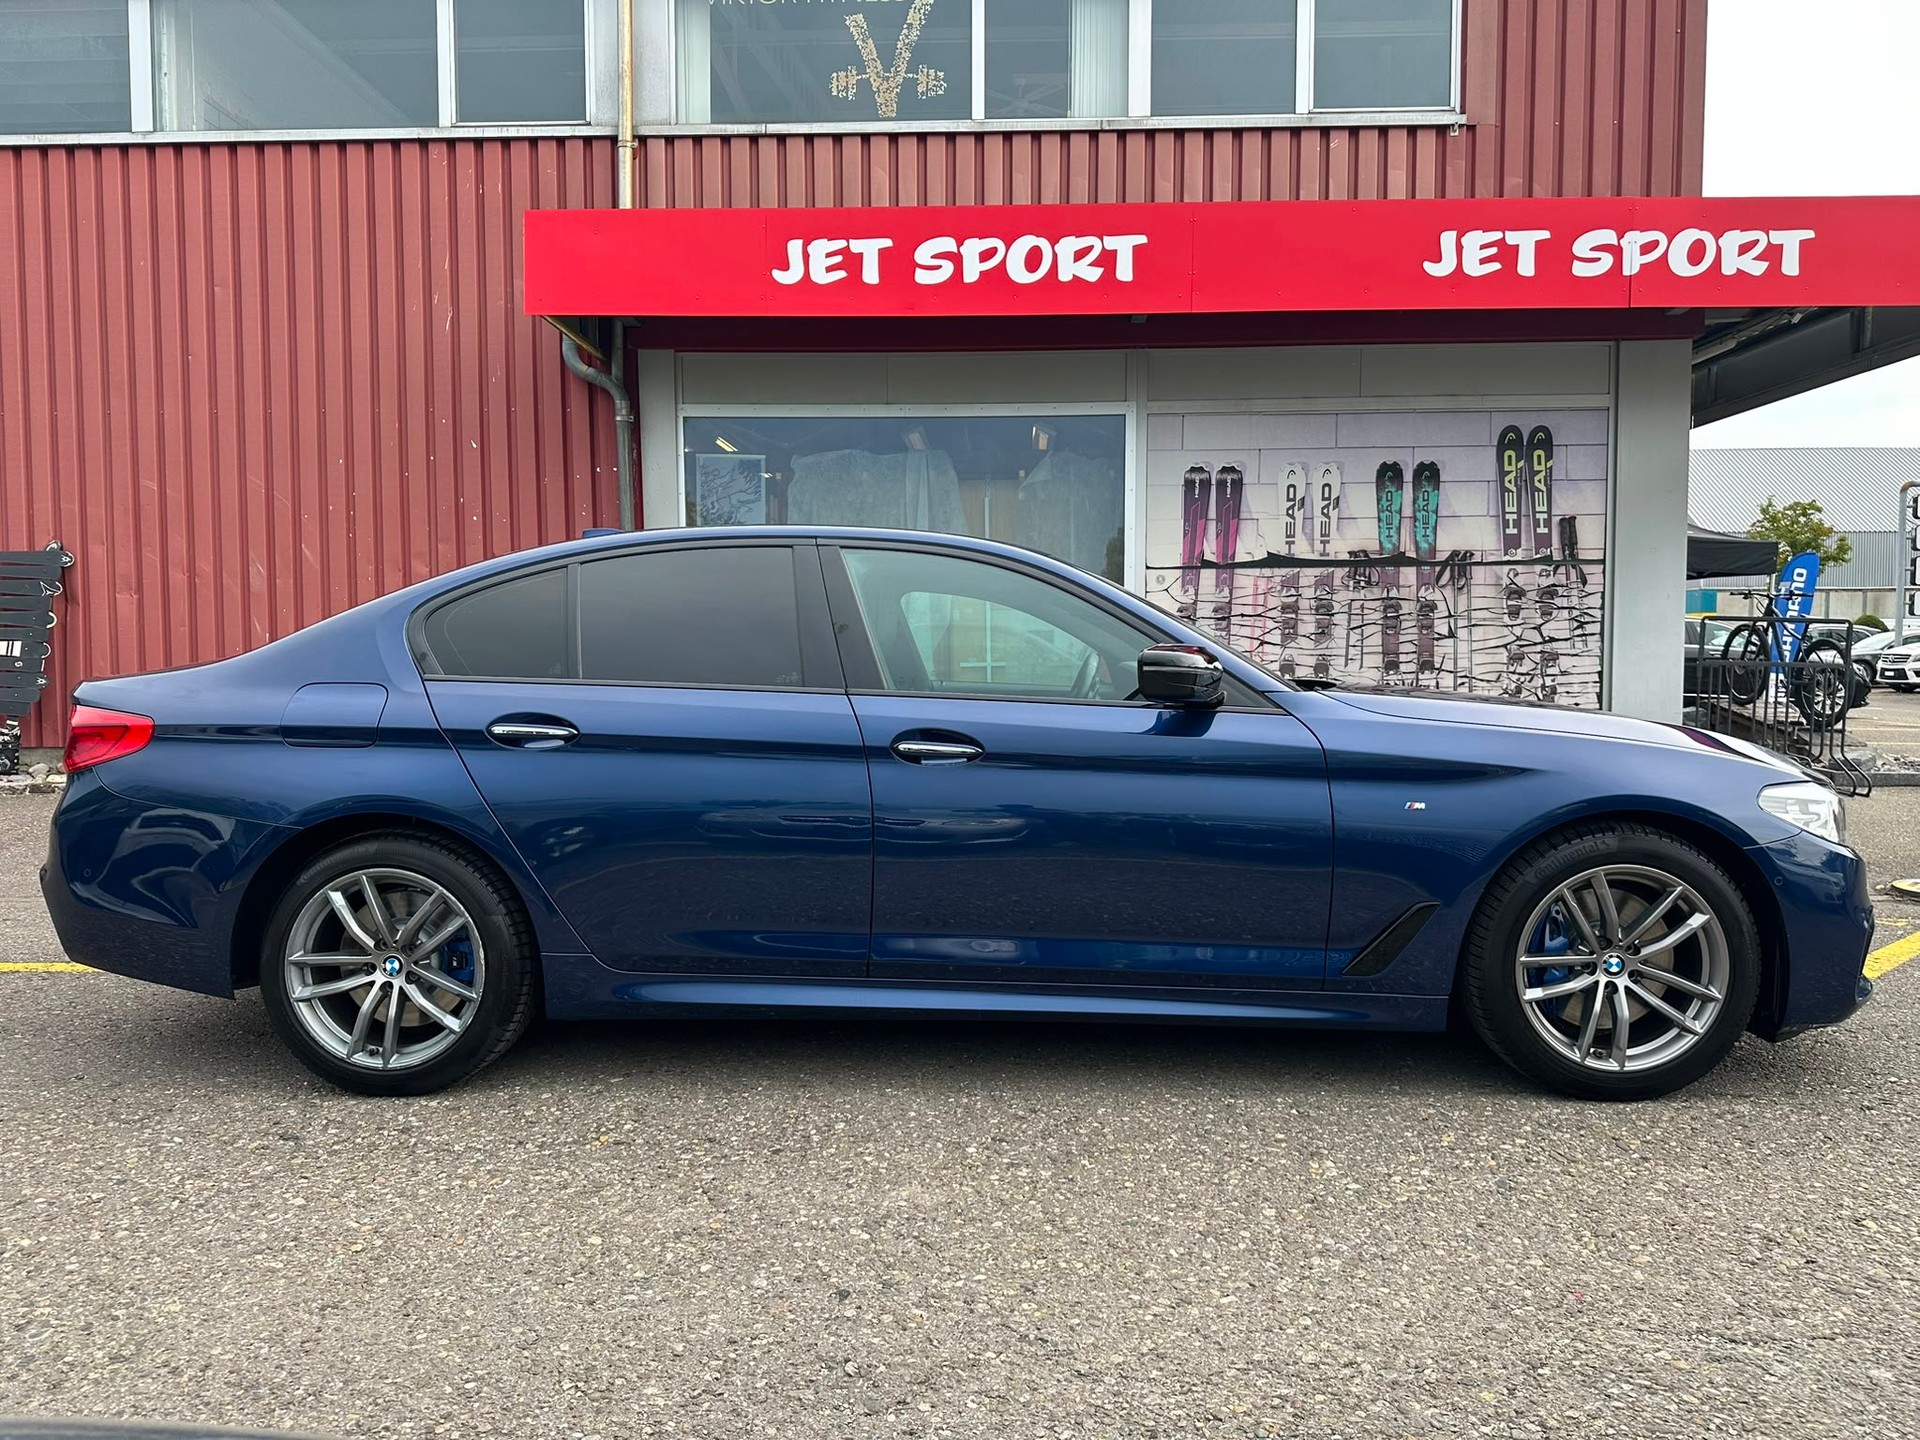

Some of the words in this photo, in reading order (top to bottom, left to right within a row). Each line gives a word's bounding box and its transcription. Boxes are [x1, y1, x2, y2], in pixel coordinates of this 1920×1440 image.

[771, 237, 894, 285] JET
[913, 234, 1149, 285] SPORT
[1422, 229, 1551, 277] JET
[1571, 227, 1816, 277] SPORT
[1285, 483, 1297, 557] HEAD
[1320, 482, 1332, 557] HEAD
[1385, 490, 1393, 538] HEAD
[1422, 489, 1430, 538] HEAD
[1503, 449, 1518, 534] HEAD
[1532, 449, 1549, 534] HEAD
